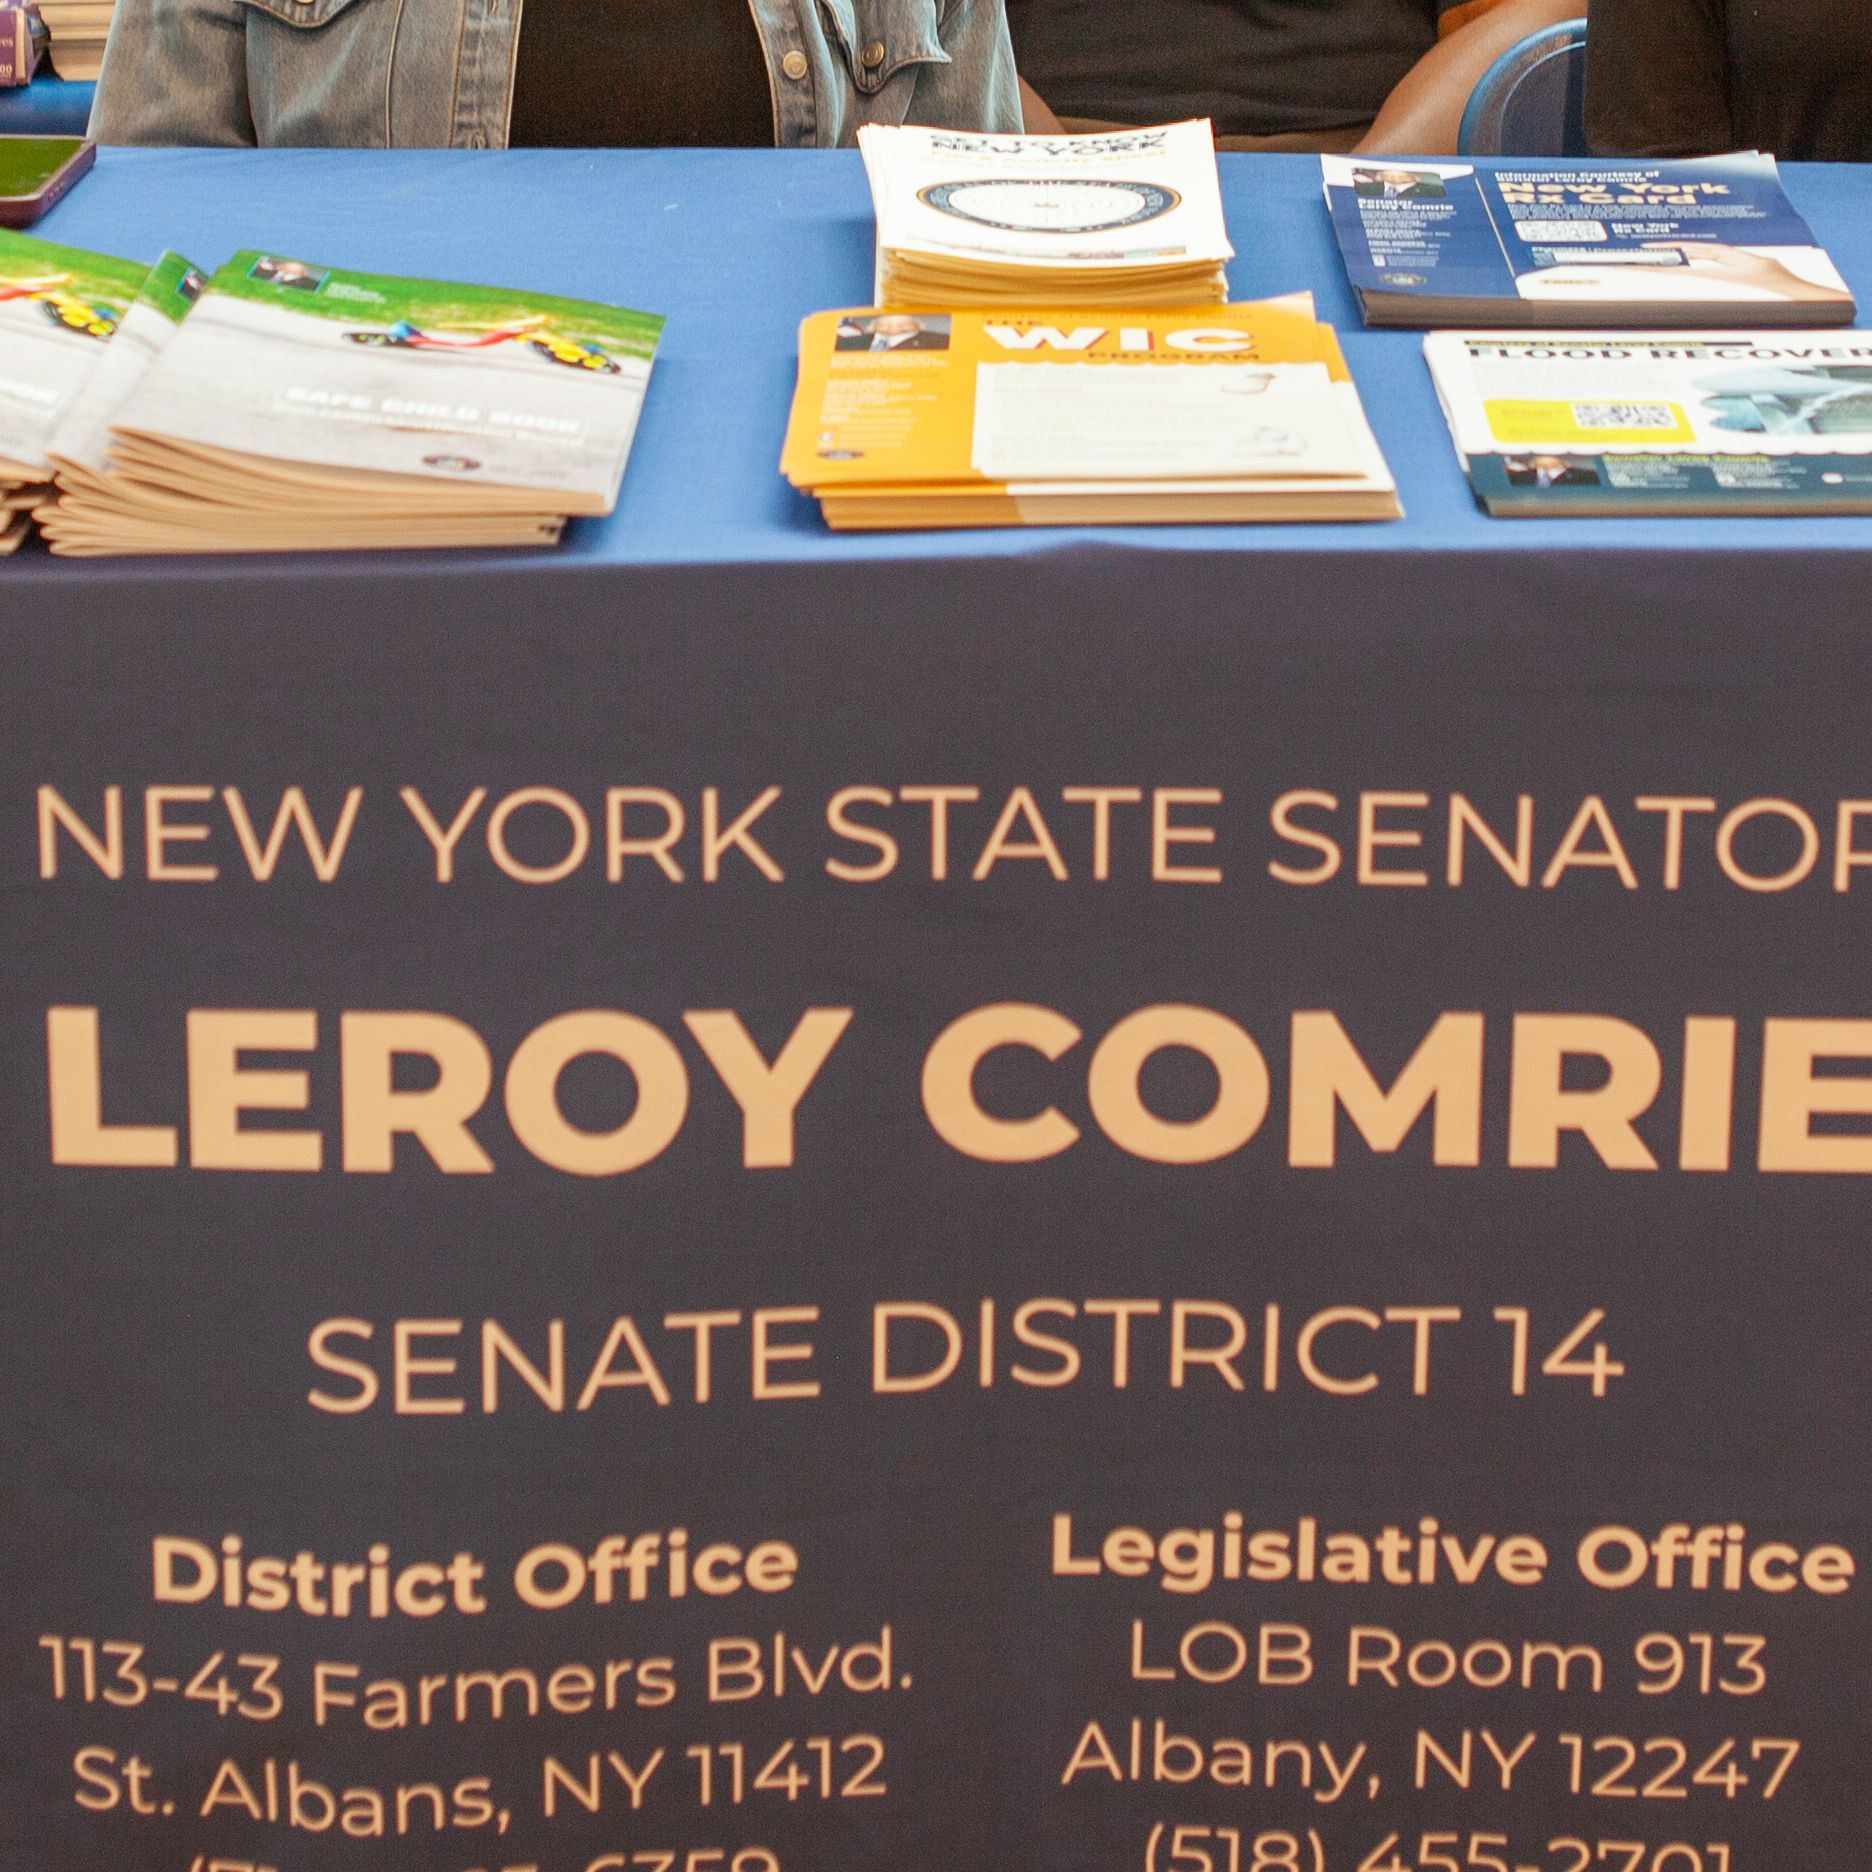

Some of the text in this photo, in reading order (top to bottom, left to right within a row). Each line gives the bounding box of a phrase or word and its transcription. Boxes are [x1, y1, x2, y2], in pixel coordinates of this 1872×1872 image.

[931, 139, 1166, 156] NEW YORK
[1498, 182, 1731, 195] New York
[1502, 192, 1697, 204] Rx Card
[983, 326, 1256, 352] WIC
[1087, 352, 1261, 361] PROGRAM
[1468, 346, 1633, 360] FLOOD
[37, 785, 362, 882] NEW
[400, 786, 783, 884] YORK
[825, 783, 1224, 884] STATE
[46, 1005, 853, 1177] LEROY
[308, 1297, 1626, 1415] SENATE DISTRICT 14
[152, 1527, 799, 1619] District Office
[1052, 1510, 1856, 1595] Legislative Office
[38, 1624, 913, 1730] 113-43 Farmers Blvd.
[1130, 1618, 1767, 1696] LOB Room 913
[72, 1733, 887, 1838] St. Albans, NY 11412
[1060, 1717, 1801, 1804] Albany, NY 12247
[1144, 1822, 1325, 1872] (518)
